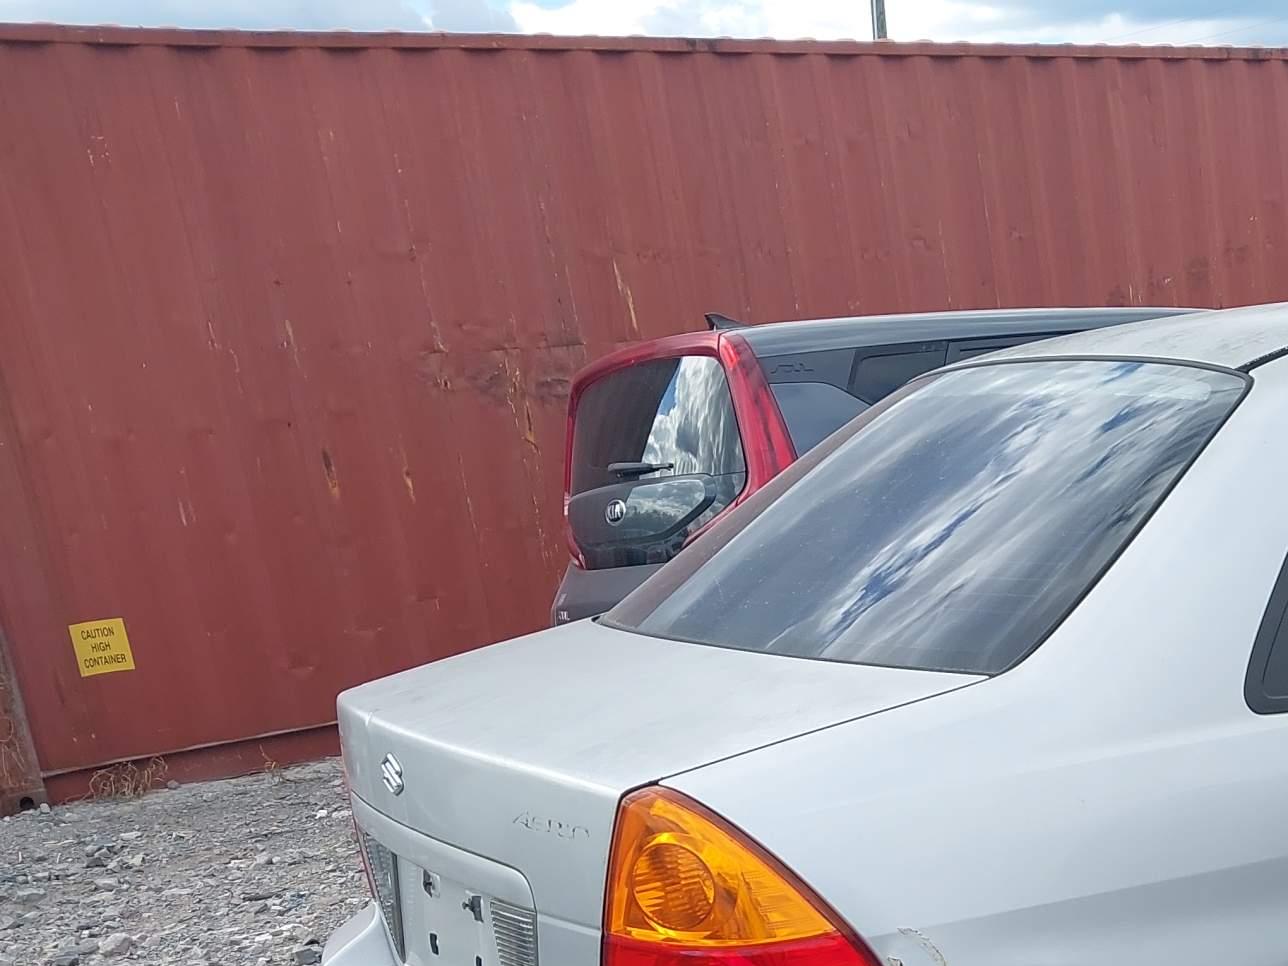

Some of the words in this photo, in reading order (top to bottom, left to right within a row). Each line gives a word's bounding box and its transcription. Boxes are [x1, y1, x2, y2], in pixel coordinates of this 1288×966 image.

[80, 626, 115, 641] CAUTION
[91, 641, 112, 653] HIGH
[83, 653, 127, 669] CONTAINER
